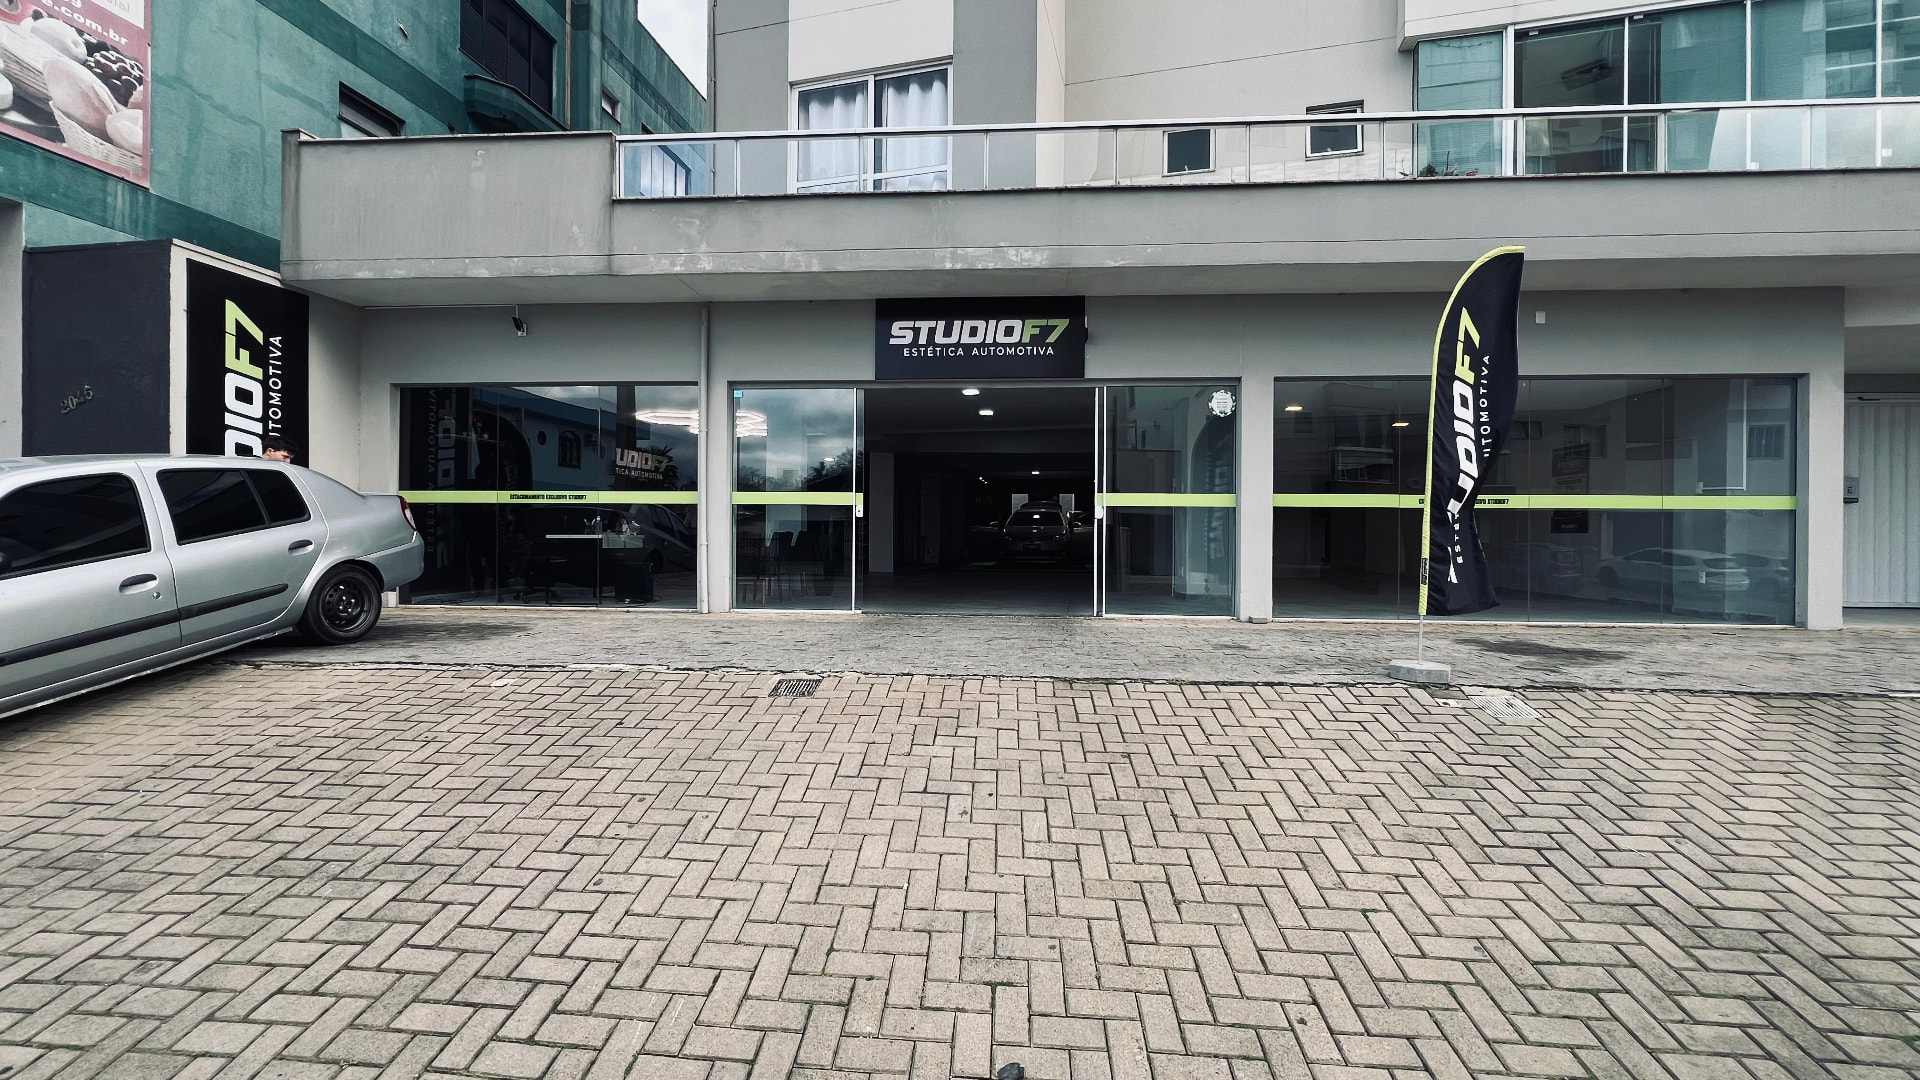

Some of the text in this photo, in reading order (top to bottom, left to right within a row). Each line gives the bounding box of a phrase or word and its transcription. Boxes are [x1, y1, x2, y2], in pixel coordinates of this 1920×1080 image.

[889, 319, 1070, 345] STUDIOF7
[903, 346, 1055, 357] ESTÉTICA AUTOMOTIVA
